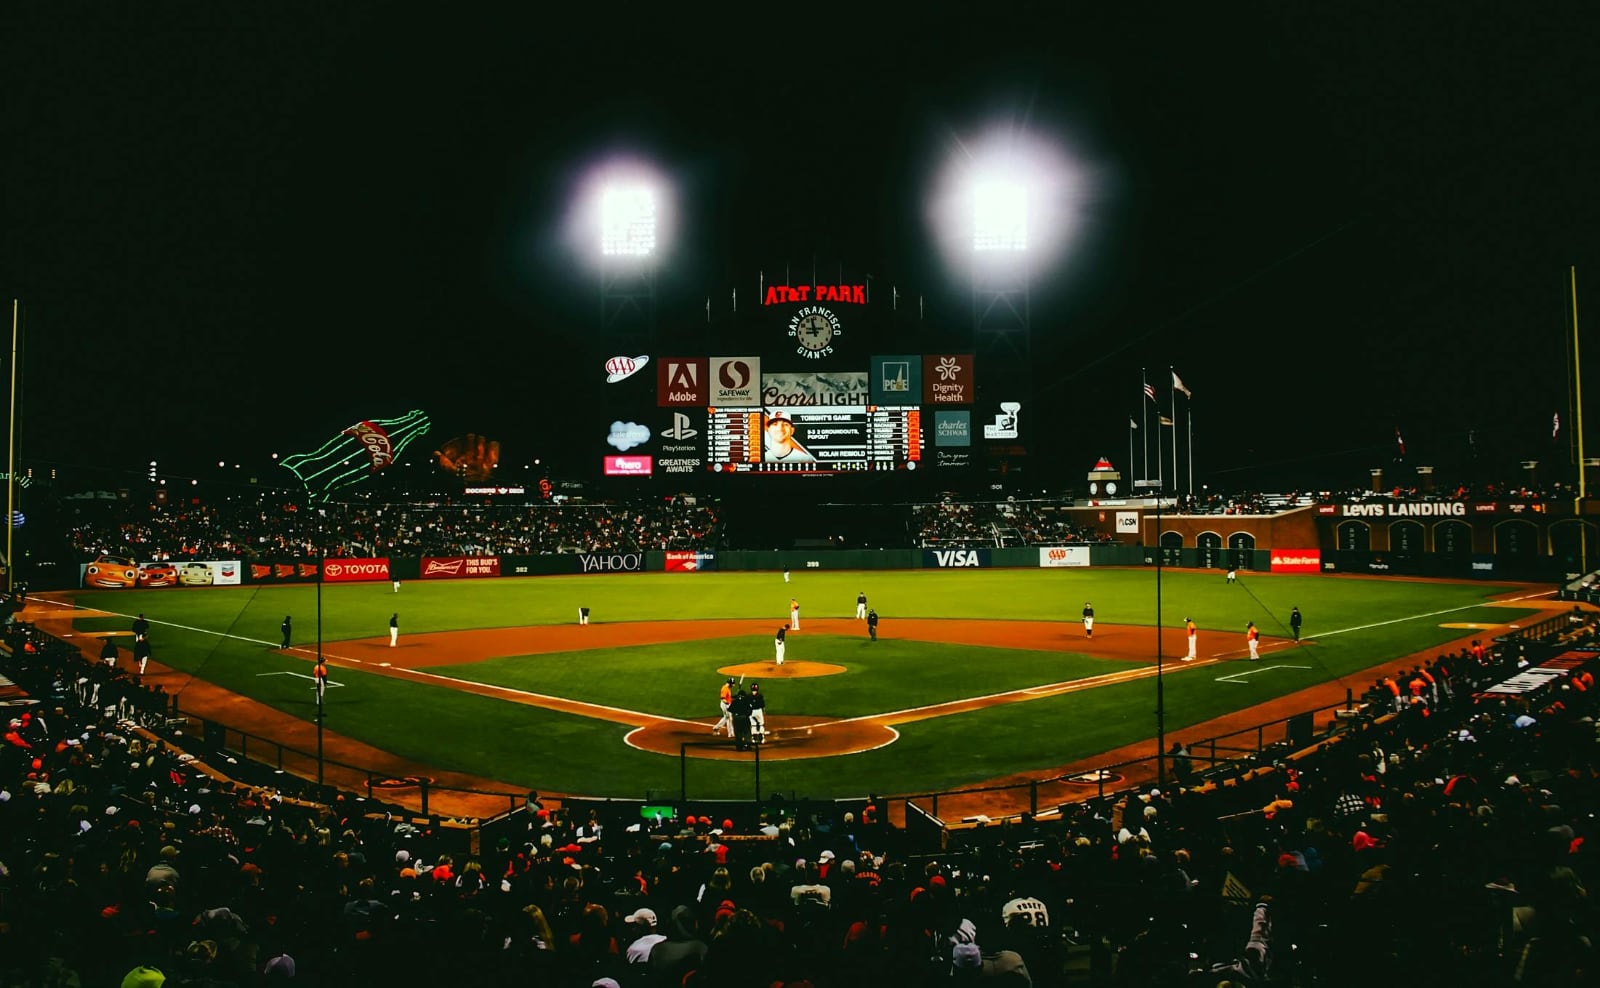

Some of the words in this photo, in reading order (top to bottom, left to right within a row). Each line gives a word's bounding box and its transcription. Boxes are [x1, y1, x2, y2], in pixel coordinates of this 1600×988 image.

[764, 286, 811, 305] AT&T
[815, 285, 865, 304] PARK
[788, 316, 800, 337] SAN
[798, 305, 842, 336] FRANCISCO
[797, 345, 834, 359] GIANTS
[606, 358, 636, 374] AAA
[933, 383, 964, 393] Dignity
[669, 392, 697, 401] Adobe
[763, 387, 818, 406] Coors
[819, 393, 869, 406] LIGHT
[934, 394, 963, 402] Health
[938, 420, 967, 429] charles
[362, 433, 392, 467] Cola
[1388, 503, 1466, 517] LANDING
[480, 558, 498, 566] BUD'S
[579, 553, 642, 573] YAHOO!
[932, 550, 980, 567] VISA
[344, 564, 389, 574] TOYOTA
[1017, 903, 1042, 911] POSEY
